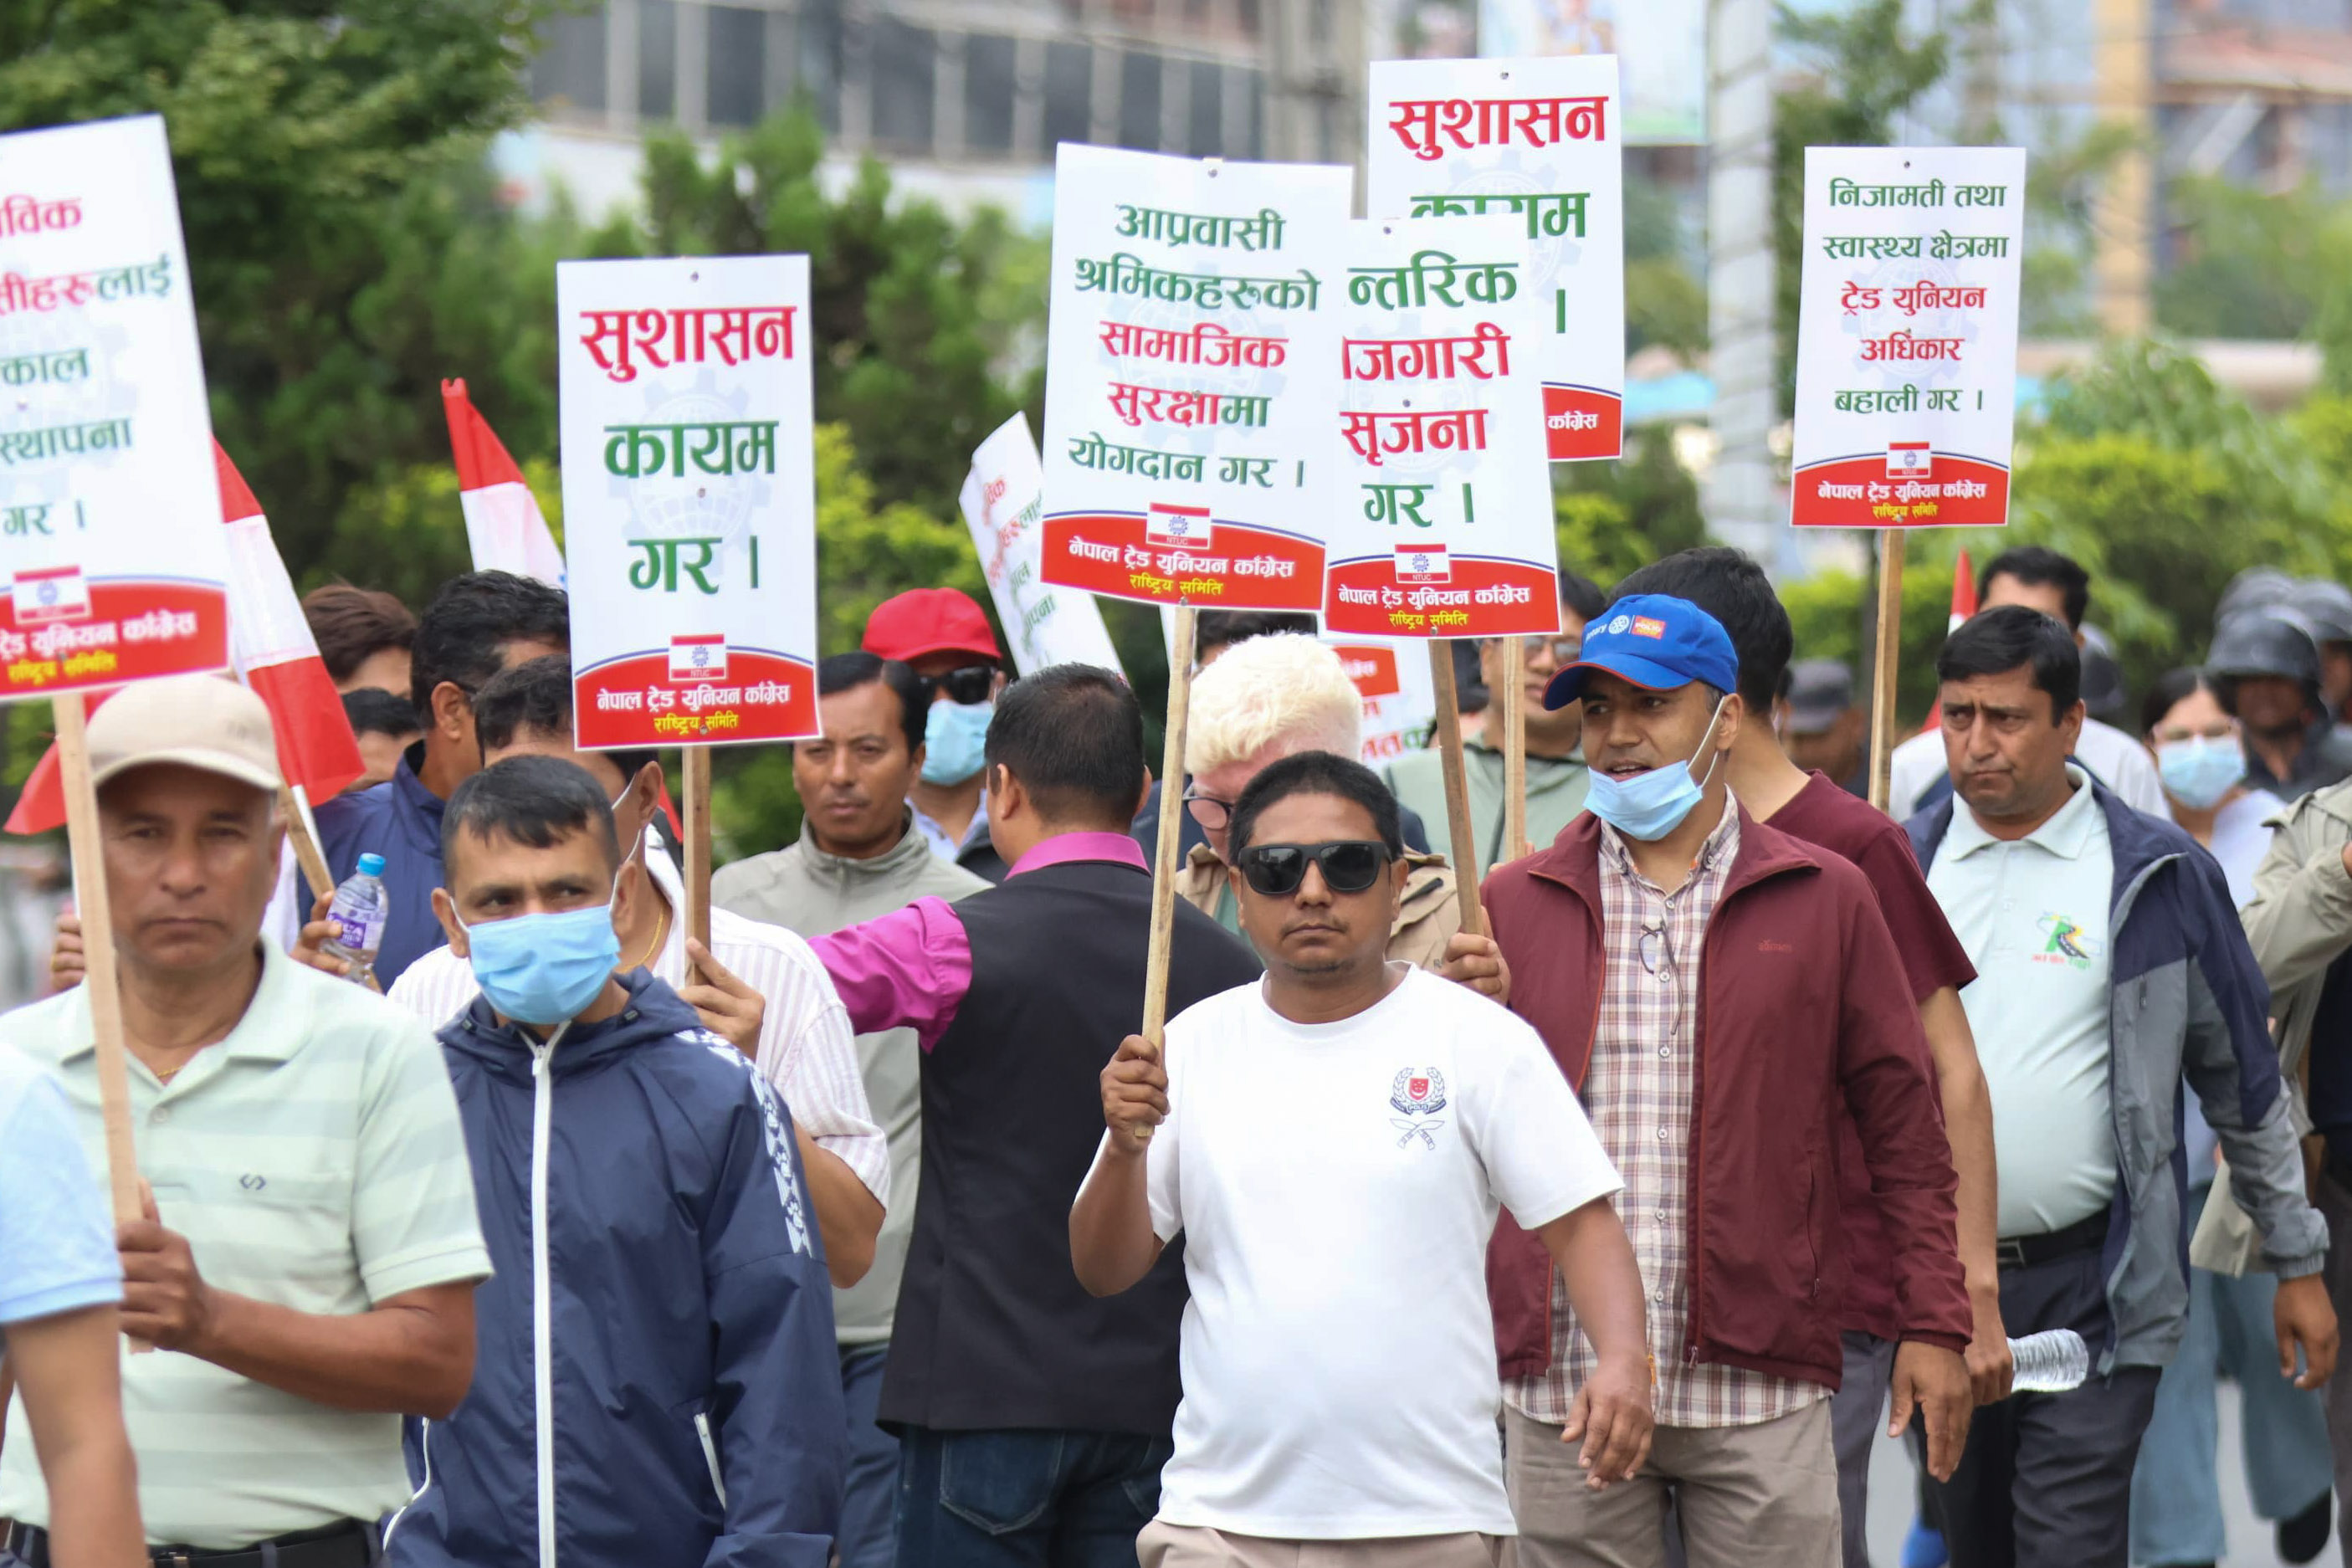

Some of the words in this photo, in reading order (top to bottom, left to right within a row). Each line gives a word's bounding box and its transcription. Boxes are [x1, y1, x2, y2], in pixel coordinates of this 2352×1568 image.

[1389, 95, 1610, 161] सुशासन
[1829, 177, 1946, 208] निजामती
[1954, 184, 2007, 208] तथा
[0, 194, 82, 237] विक
[1115, 204, 1287, 252] आप्रवासी
[1822, 235, 1923, 260] स्वास्थ्य
[1929, 229, 2010, 261] क्षेत्रमा
[1345, 249, 1519, 310] न्तरिक
[1841, 280, 1883, 316] ट्रेड
[1893, 280, 1987, 316] युनियन
[580, 306, 797, 383] सुशासन
[1099, 320, 1289, 368] सामाजिक
[1860, 330, 1965, 361] अधिकार
[0, 348, 88, 386] काल
[1108, 382, 1273, 428] सुरक्षामा
[1835, 382, 1919, 414] बहाली
[1927, 389, 1963, 412] गर
[604, 420, 780, 479] कायम
[1340, 408, 1489, 467] सृजना
[1068, 432, 1207, 482] योगदान
[1219, 457, 1278, 488] गर
[1360, 484, 1434, 528] गर
[1817, 480, 1865, 501] नेपाल
[1867, 480, 1892, 503] ट्रेड
[1895, 480, 1940, 503] युनियन
[3, 503, 54, 535] गर
[628, 537, 723, 596] गर
[1068, 535, 1120, 562] नेपाल
[1124, 544, 1152, 569] ट्रेड
[1156, 551, 1229, 576] युनियन
[1180, 577, 1224, 596] समिति
[1412, 573, 1432, 582] NTUC
[1338, 583, 1378, 605] नेपाल
[1381, 586, 1402, 608] ट्रेड
[1407, 587, 1470, 611] युनियन
[1429, 609, 1469, 628] समिति
[597, 687, 642, 711] नेपाल
[648, 686, 676, 712] ट्रेड
[682, 683, 741, 711] युनियन
[705, 710, 739, 730] समिति
